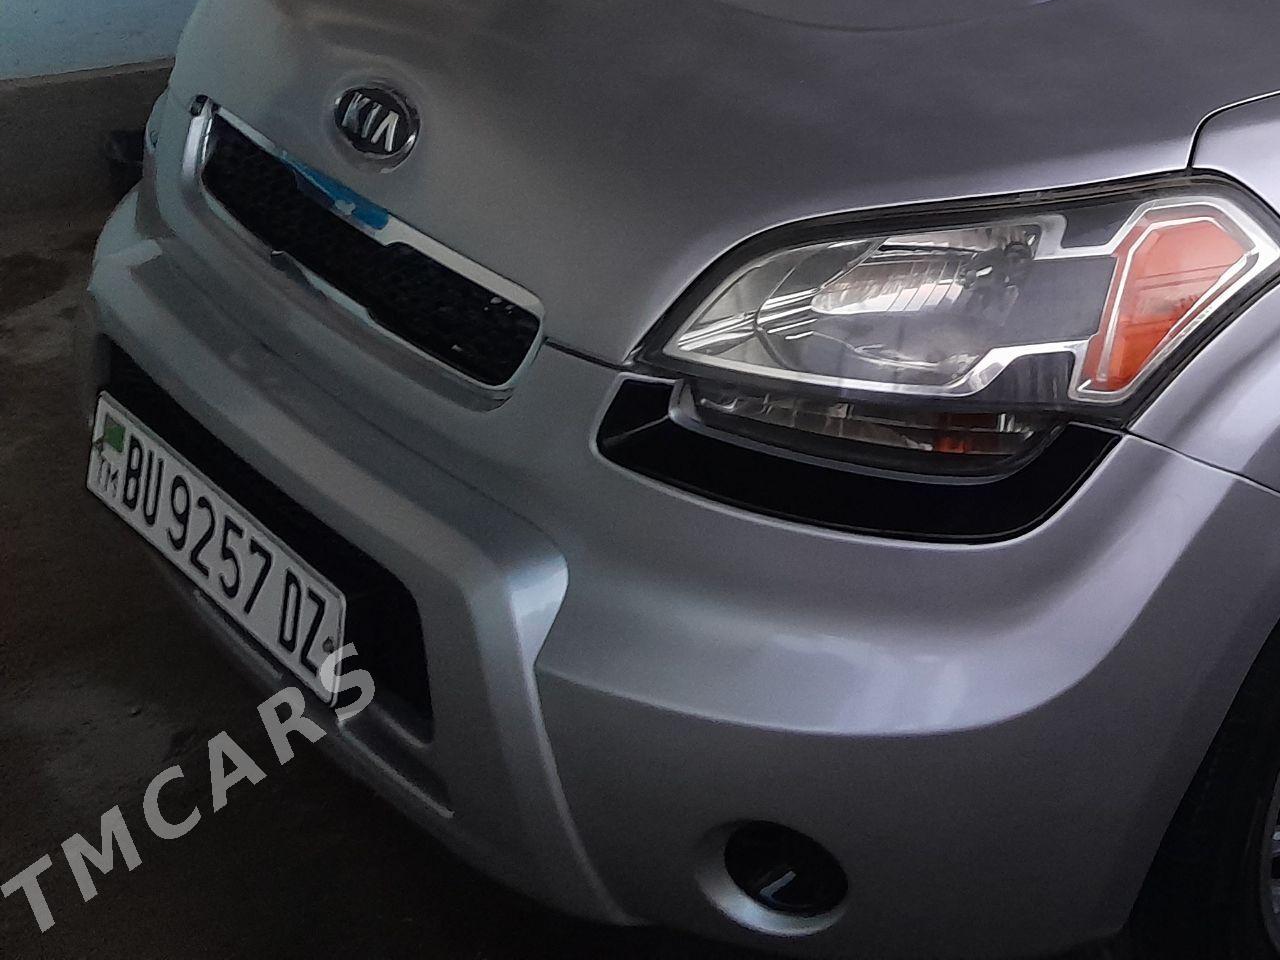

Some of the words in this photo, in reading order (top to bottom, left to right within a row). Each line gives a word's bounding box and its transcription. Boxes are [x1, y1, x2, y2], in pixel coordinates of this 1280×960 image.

[341, 91, 400, 152] KIA
[123, 434, 164, 526] BU
[166, 474, 272, 615] 9257
